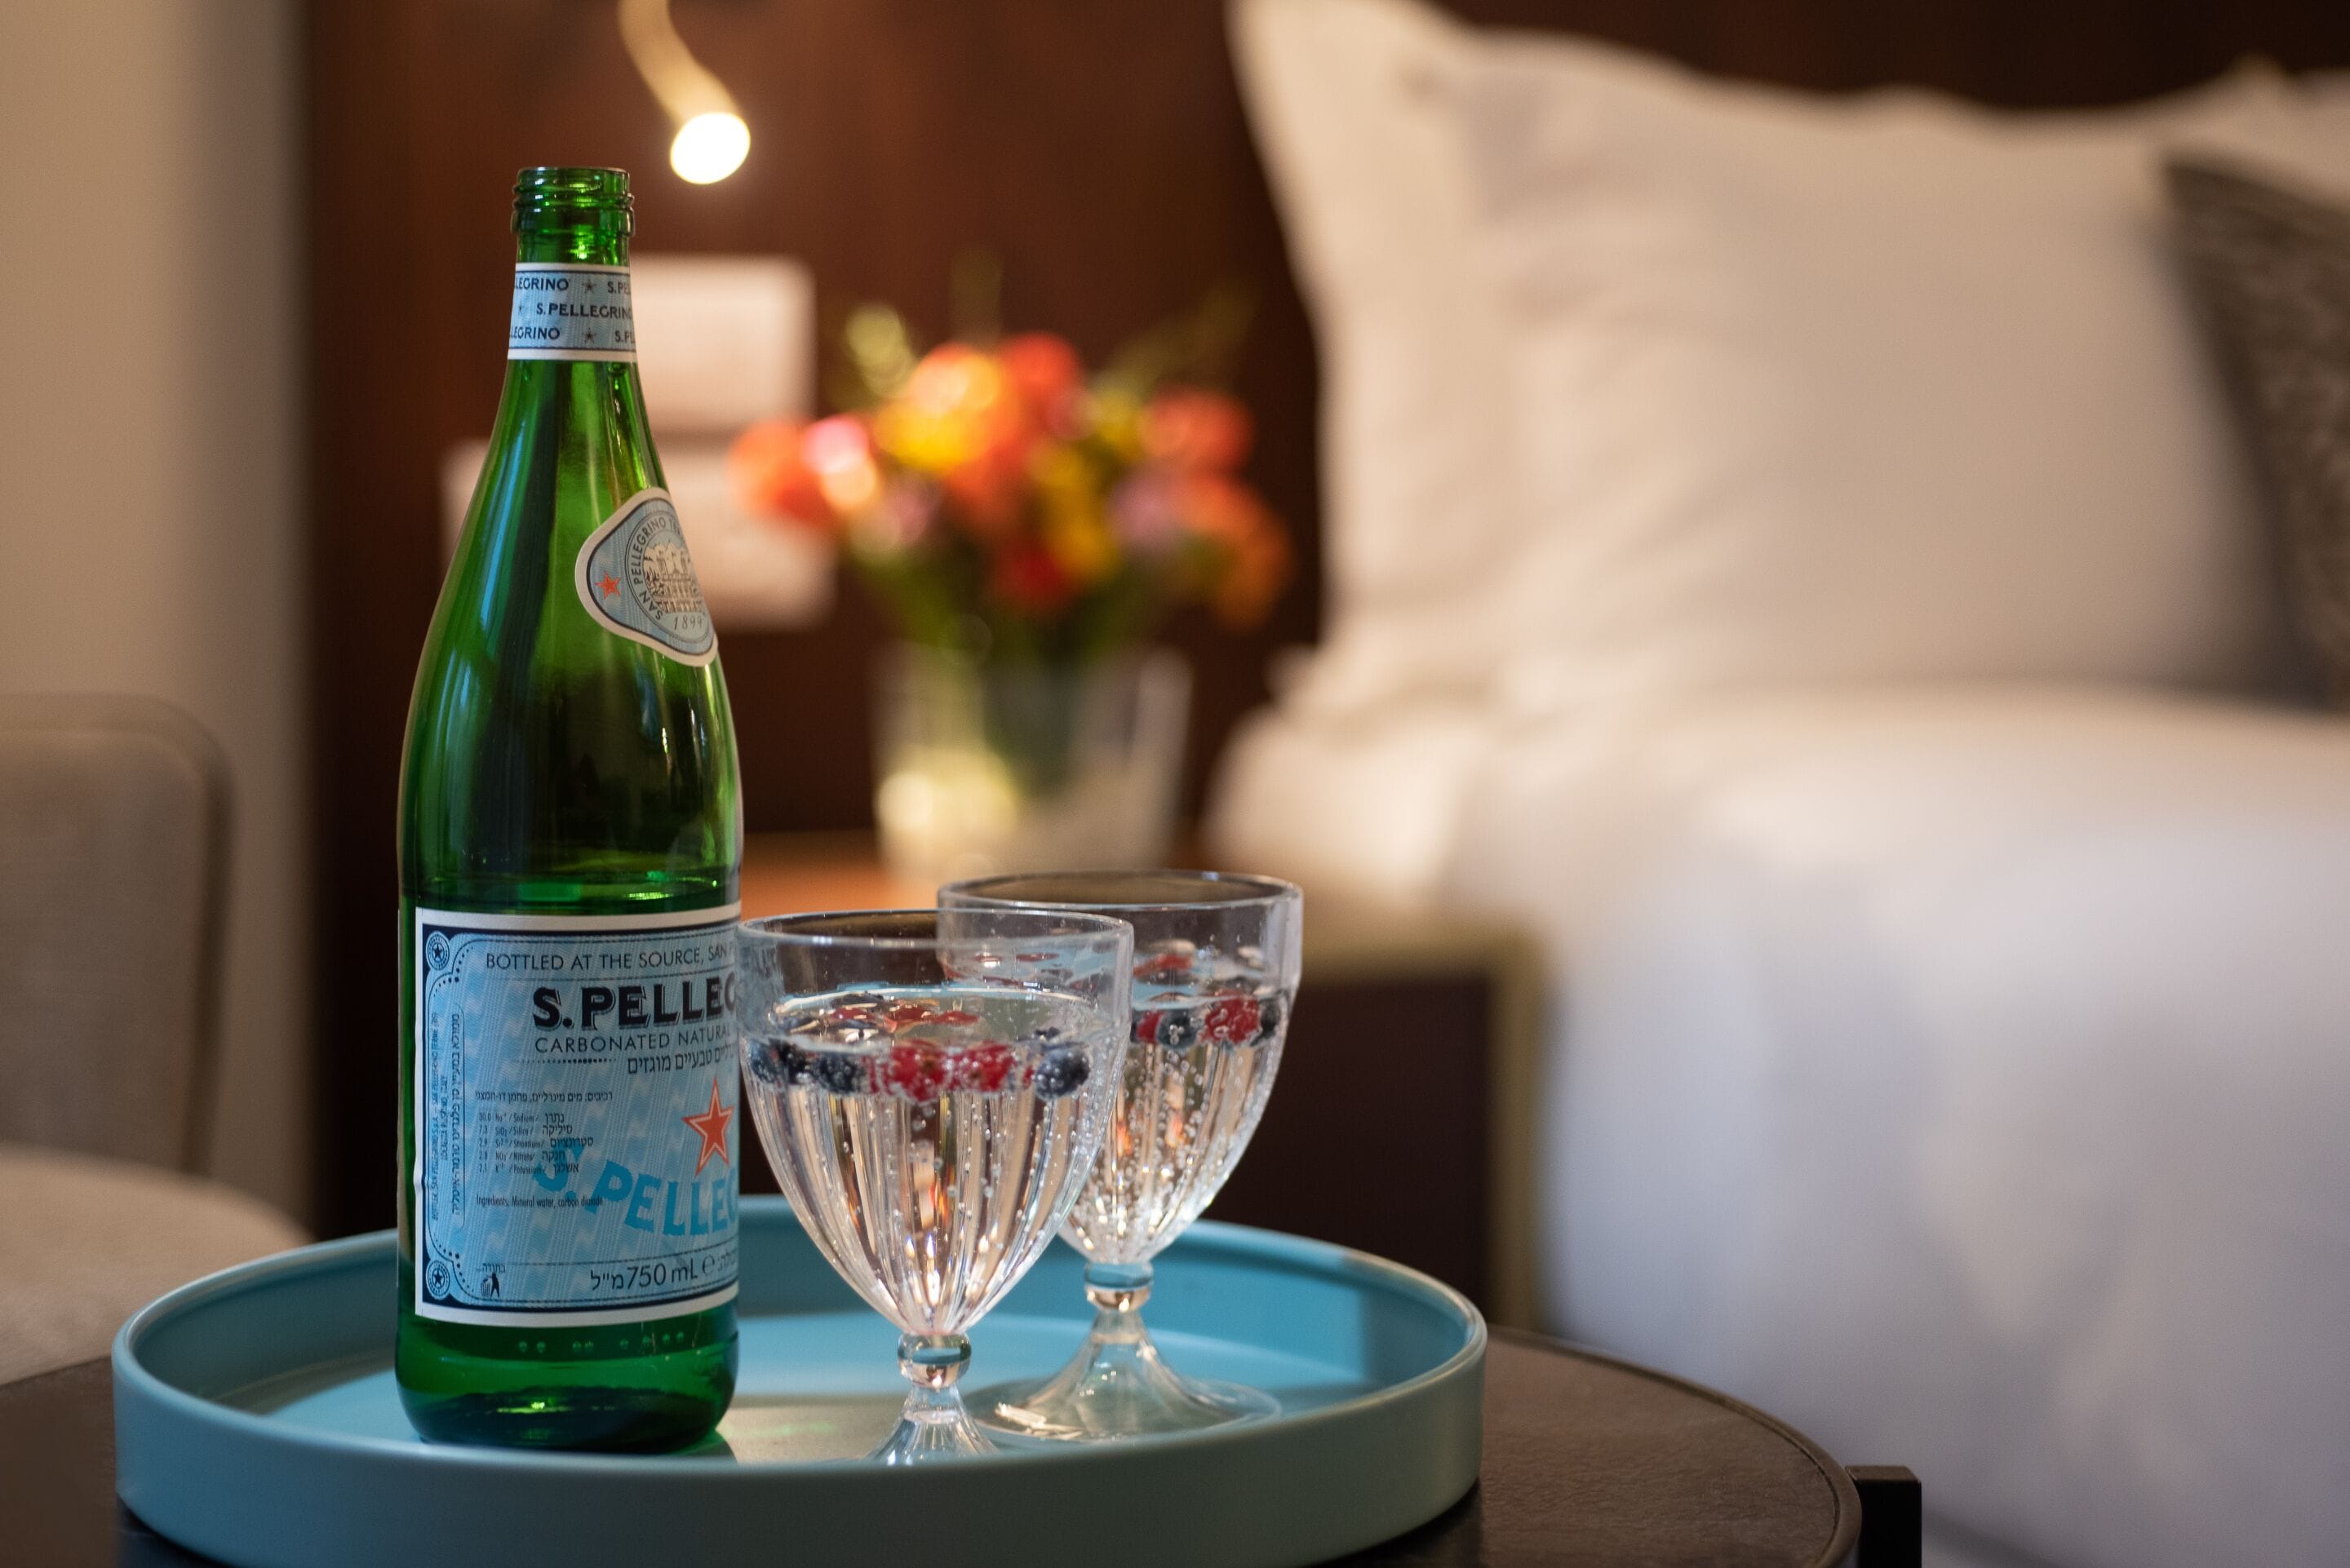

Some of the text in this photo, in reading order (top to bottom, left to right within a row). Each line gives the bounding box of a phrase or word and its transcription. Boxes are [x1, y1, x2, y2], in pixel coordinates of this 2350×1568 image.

[630, 516, 667, 587] PELLEGRINO
[486, 952, 565, 972] BOTTLED
[571, 953, 592, 970] AT
[599, 951, 632, 969] THE
[639, 946, 704, 968] SOURCE,
[707, 943, 728, 961] SAN
[534, 1025, 731, 1053] CARBONATED NATURAL
[627, 1054, 672, 1074] מוגזים
[674, 1049, 712, 1071] טבעיים
[567, 1092, 583, 1102] מים
[512, 1195, 534, 1207] Mineral
[557, 1196, 579, 1208] carbon
[671, 1259, 698, 1283] mL
